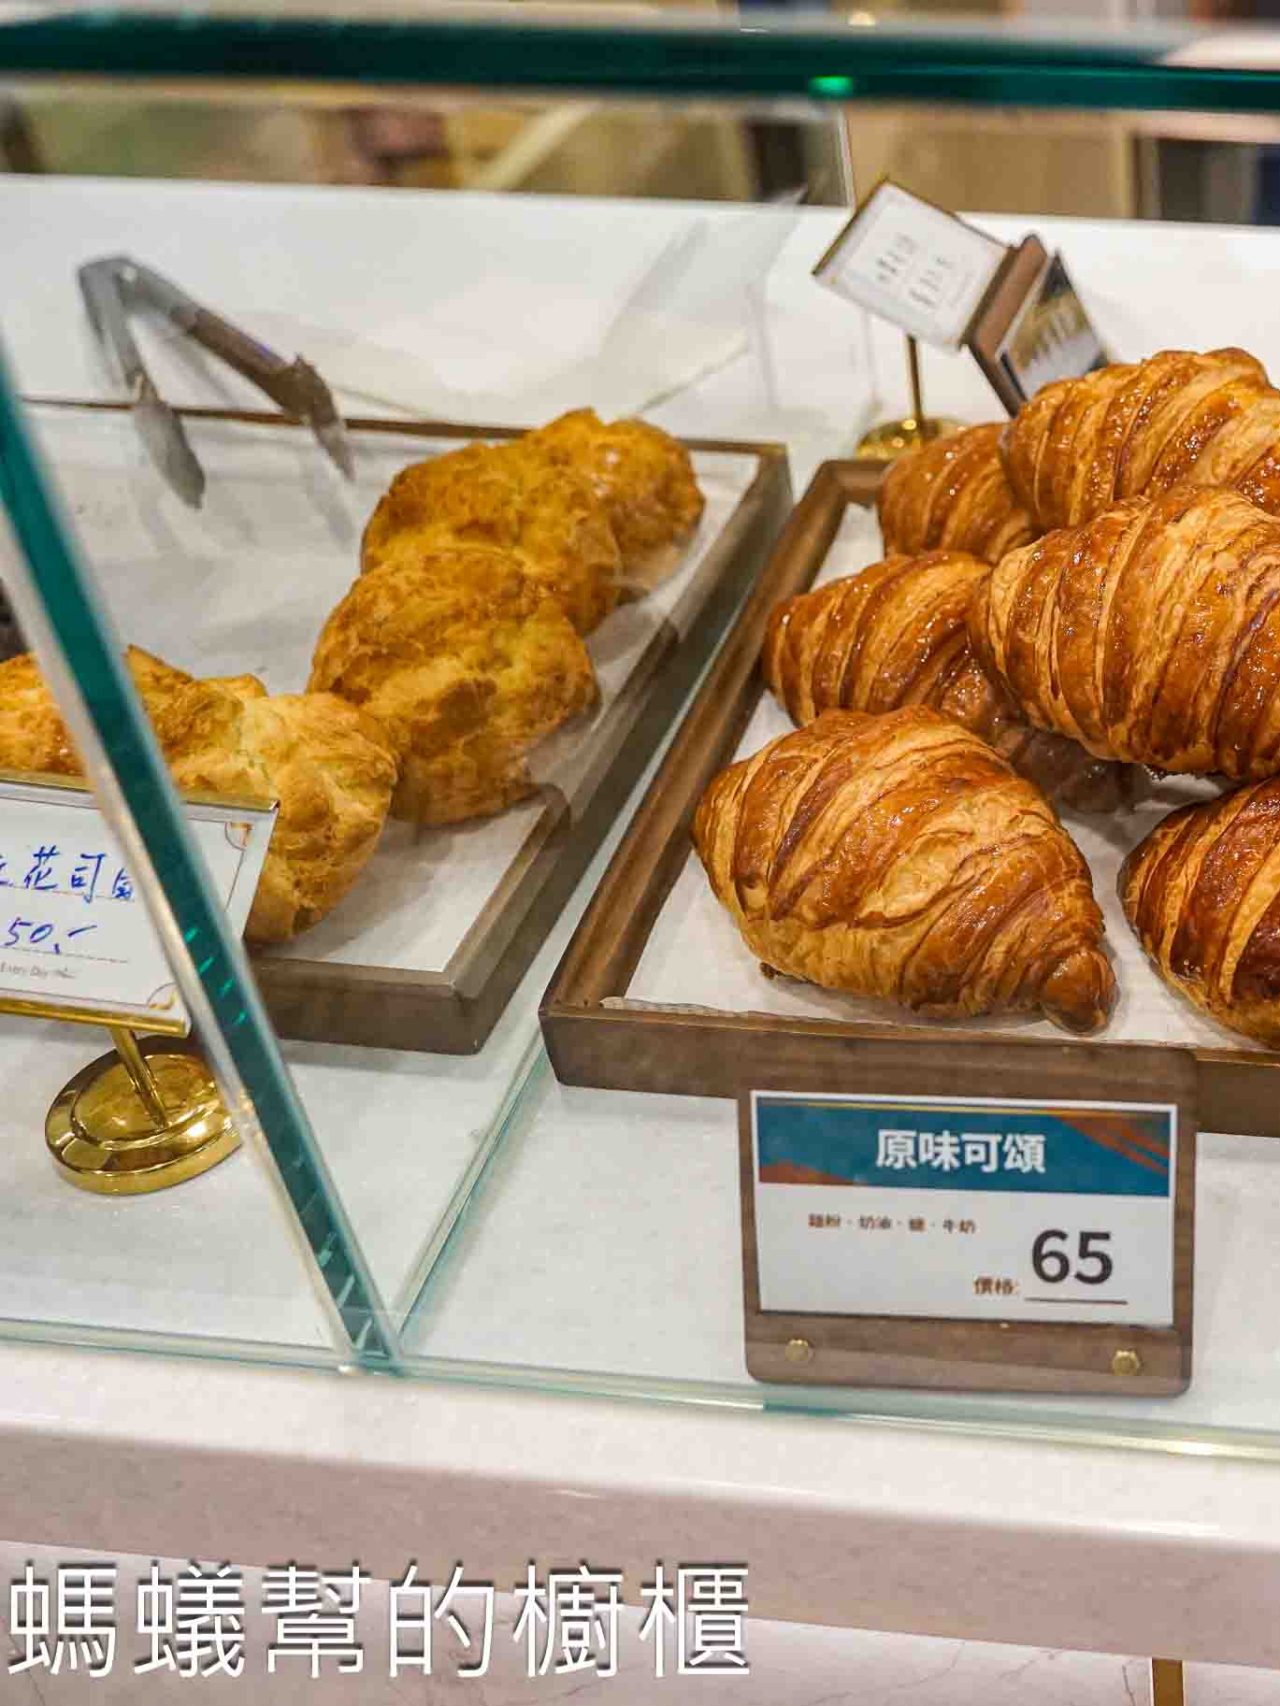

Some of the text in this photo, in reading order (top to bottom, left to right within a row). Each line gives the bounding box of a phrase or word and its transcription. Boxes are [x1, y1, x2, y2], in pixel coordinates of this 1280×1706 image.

[876, 1129, 1046, 1174] 原味可頌
[1031, 1228, 1114, 1286] 65
